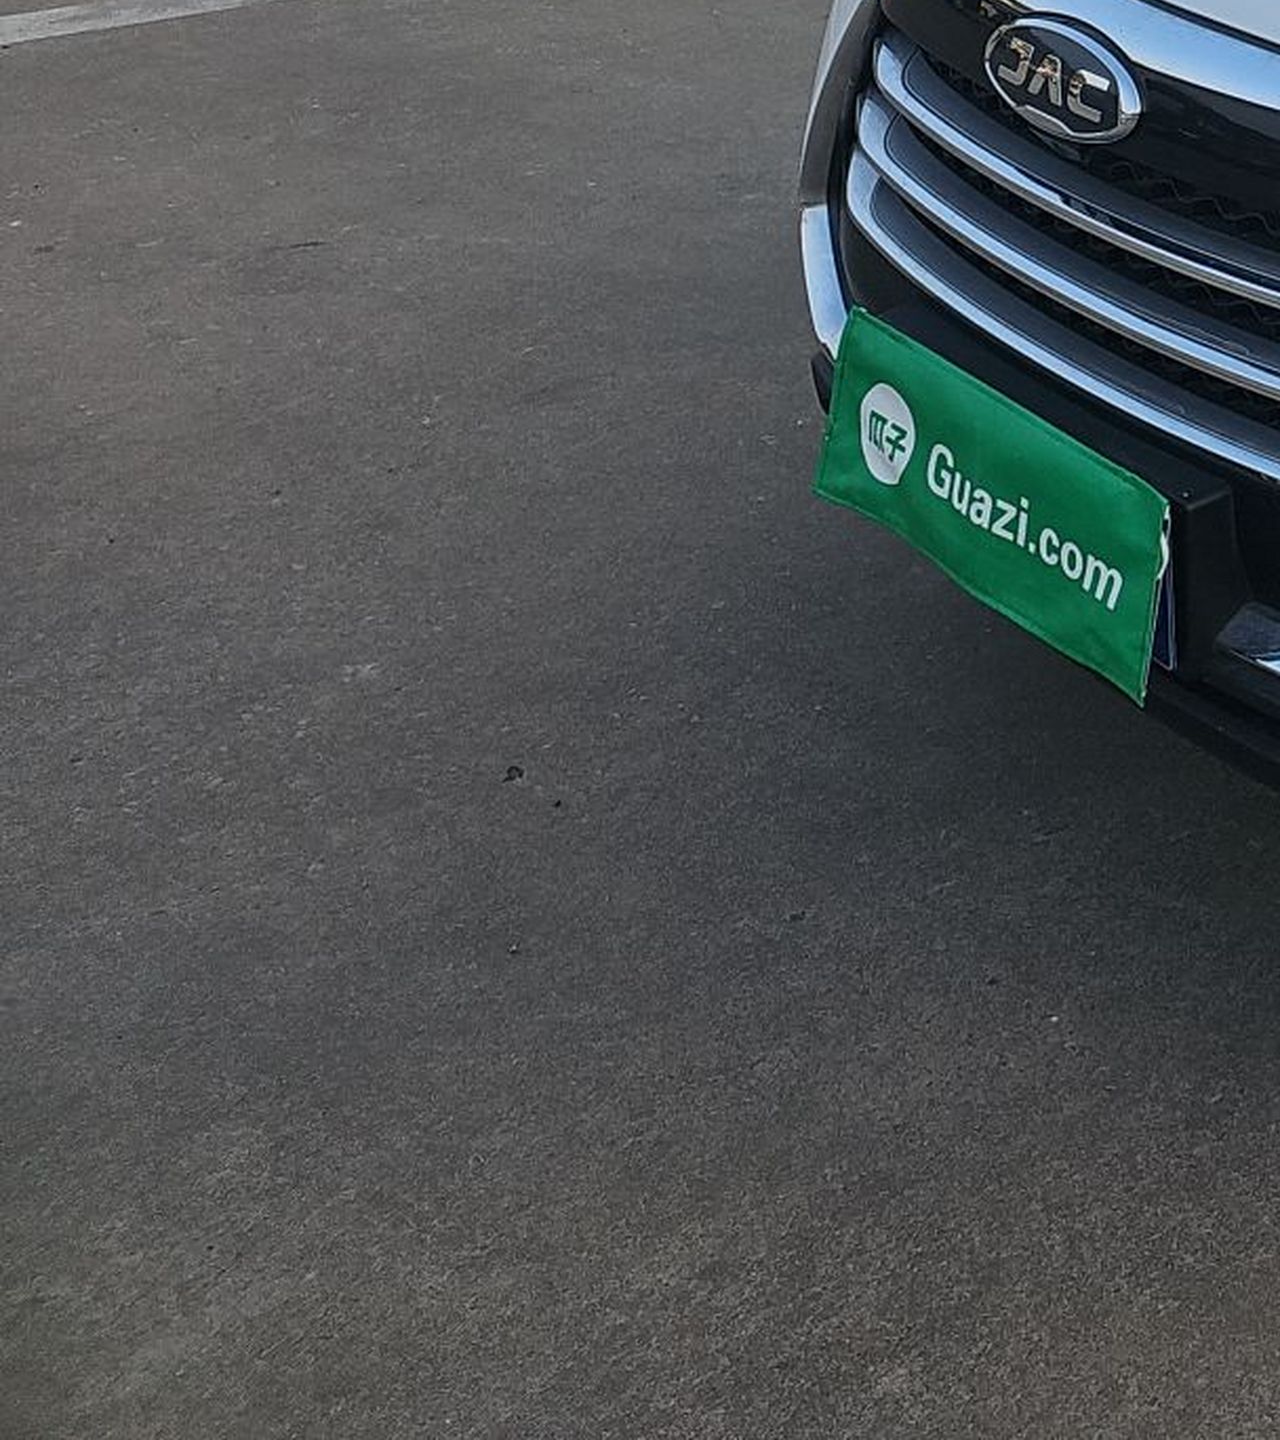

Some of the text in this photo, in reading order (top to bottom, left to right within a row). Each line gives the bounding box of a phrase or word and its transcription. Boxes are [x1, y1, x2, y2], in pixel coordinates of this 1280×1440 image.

[998, 36, 1110, 123] JAC
[869, 409, 908, 462] 瓜子
[926, 443, 1124, 610] Guazi.com
